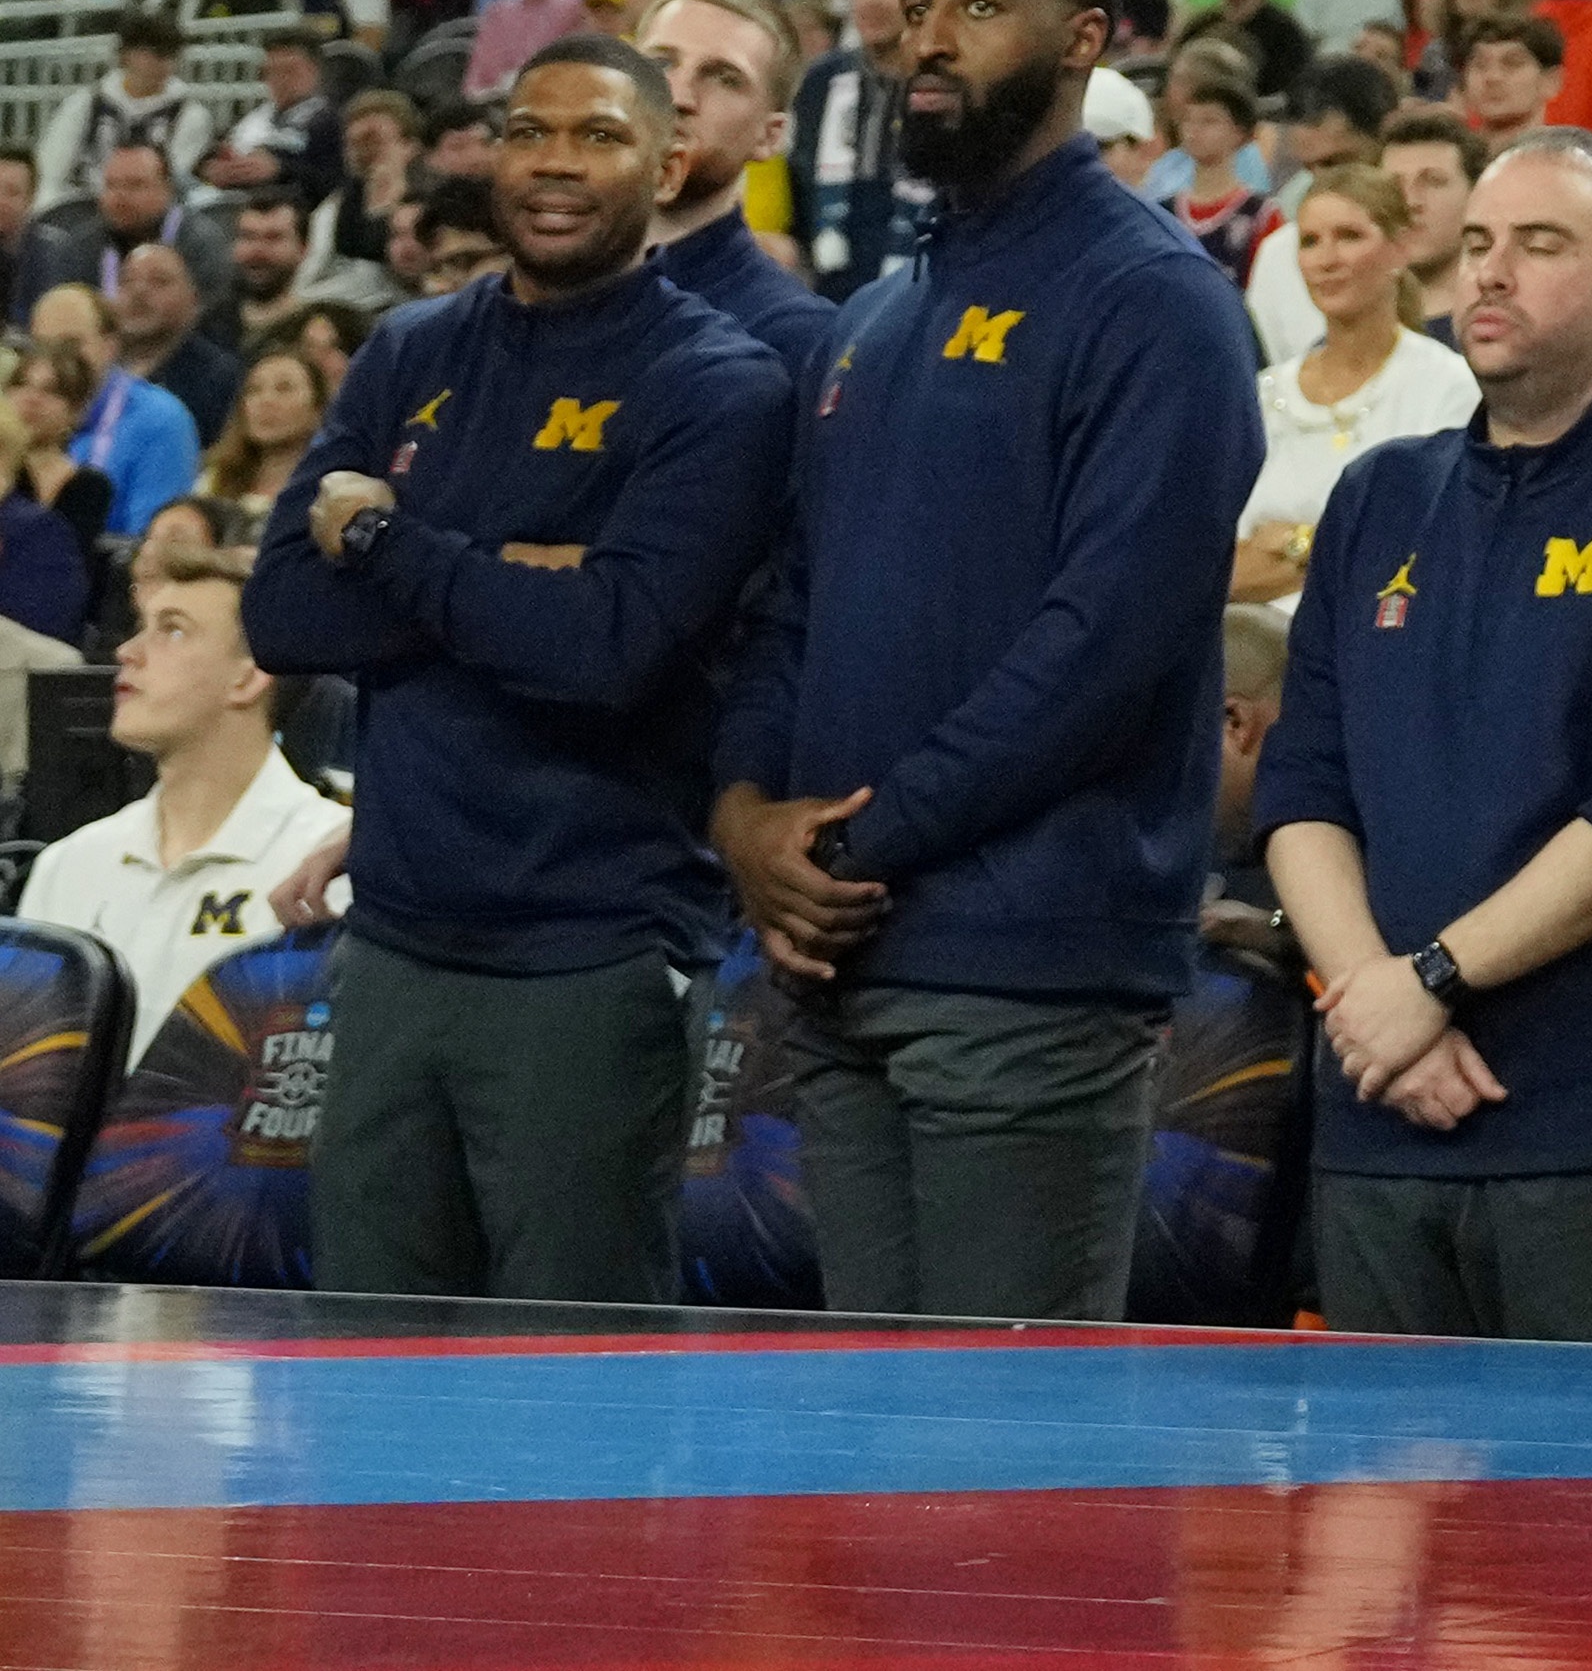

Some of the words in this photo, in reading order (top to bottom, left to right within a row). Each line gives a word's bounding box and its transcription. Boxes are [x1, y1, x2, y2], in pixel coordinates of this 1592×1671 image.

[942, 305, 1027, 364] M
[533, 397, 624, 451] M
[190, 890, 254, 937] M
